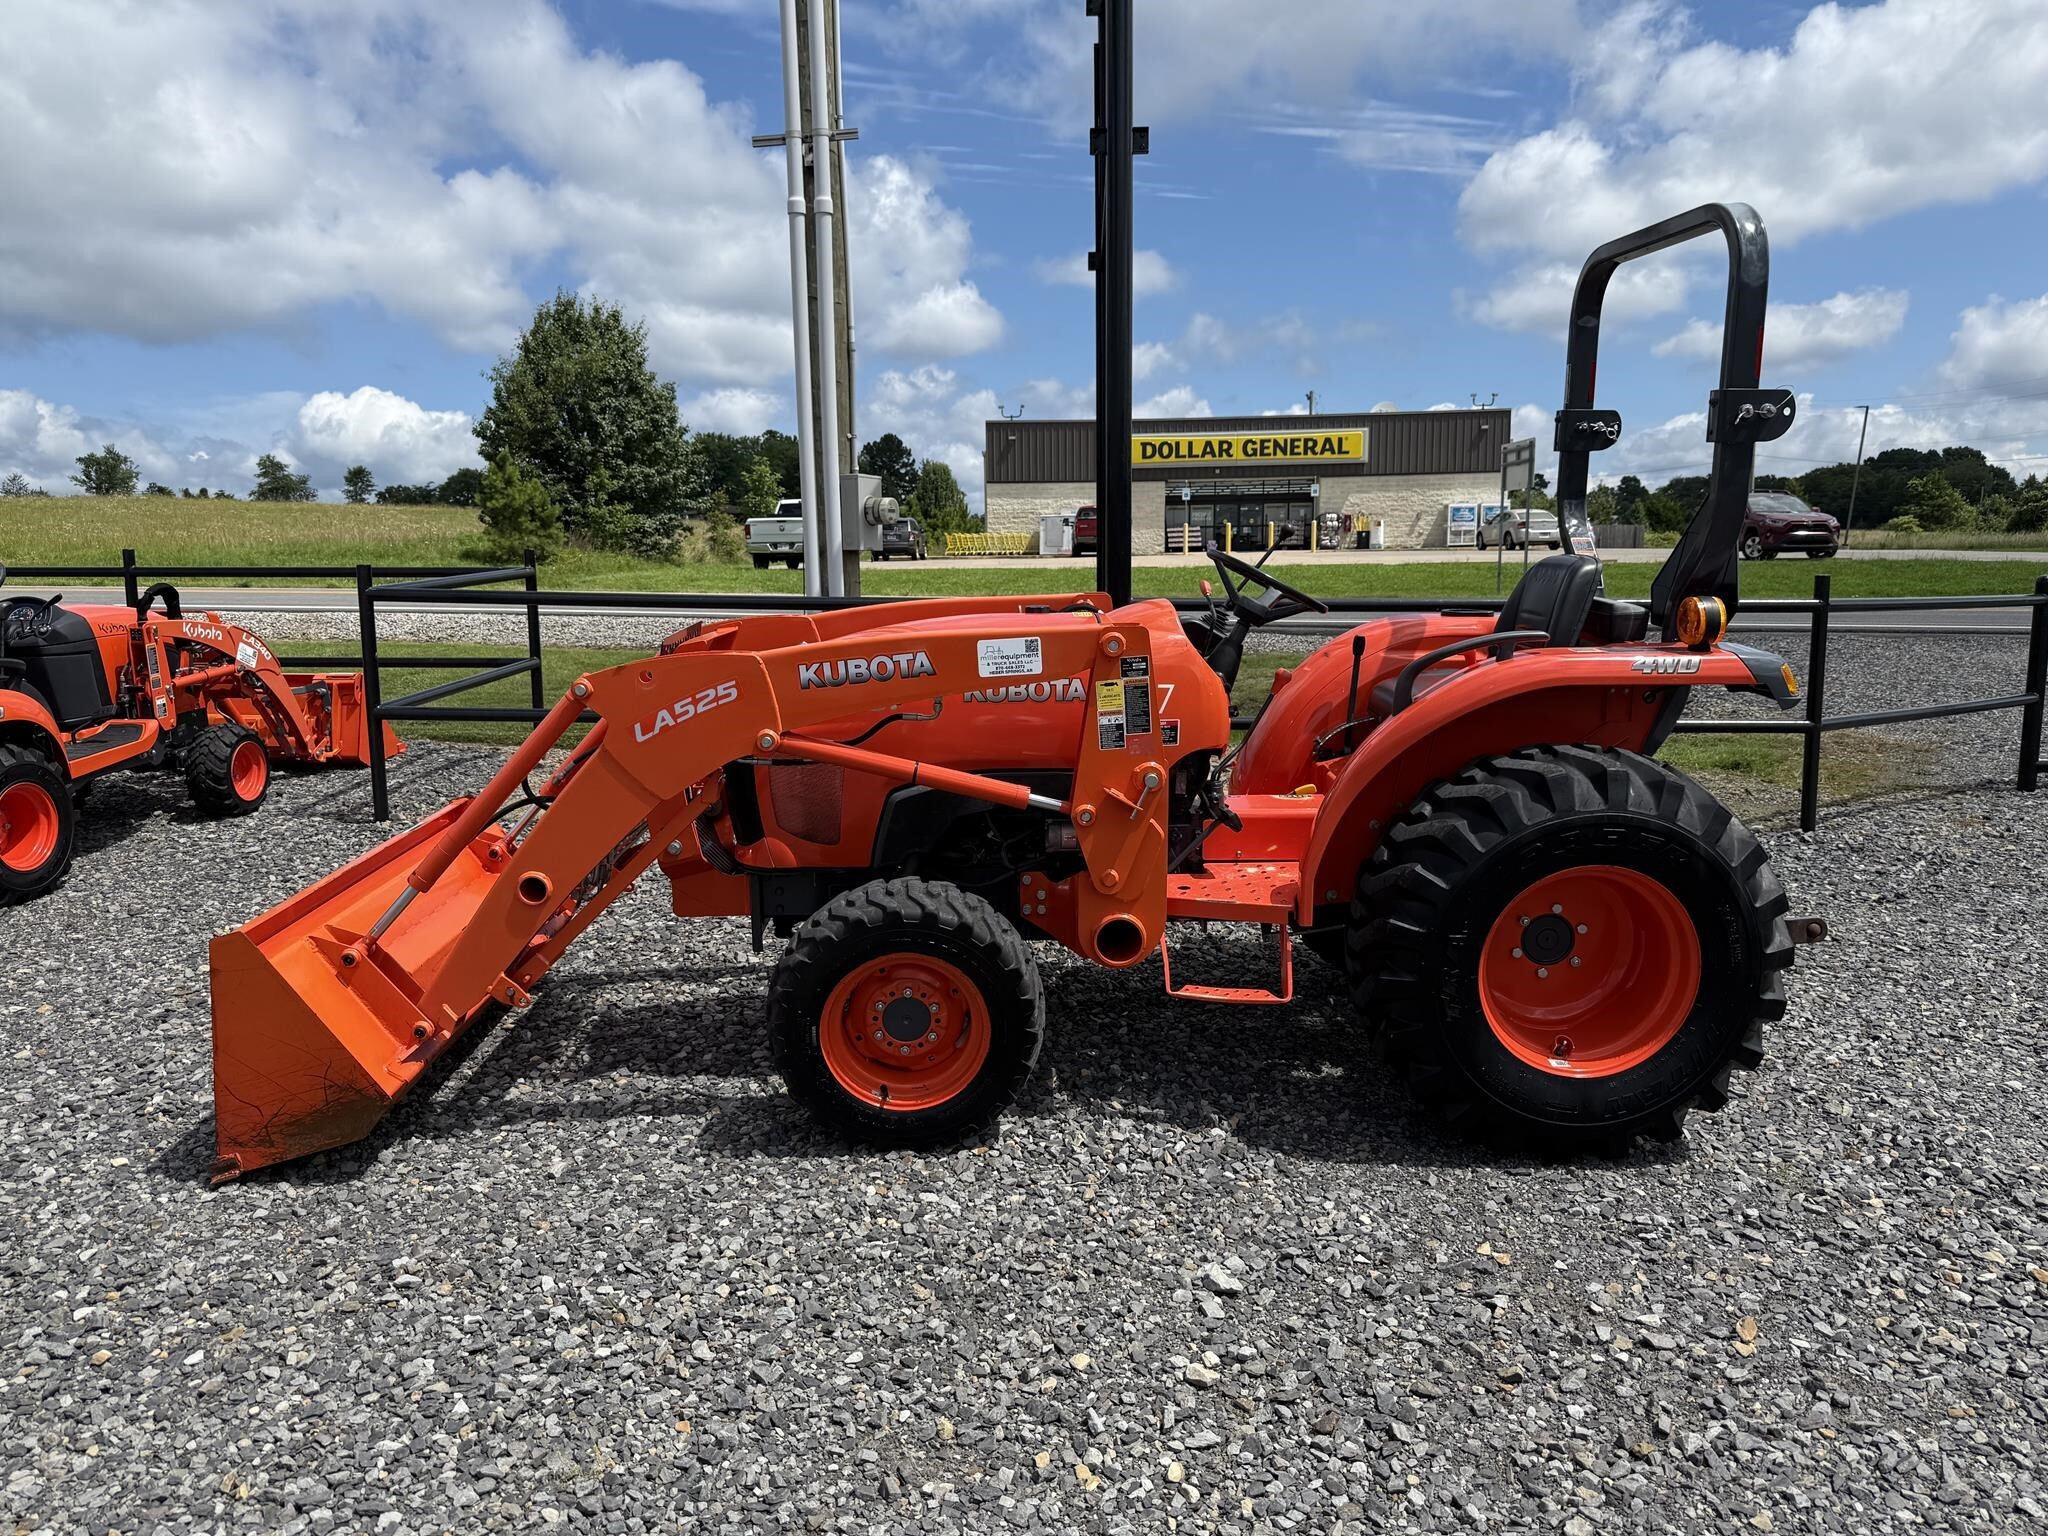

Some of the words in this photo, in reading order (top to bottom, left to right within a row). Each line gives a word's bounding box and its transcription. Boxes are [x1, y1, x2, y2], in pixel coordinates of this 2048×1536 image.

[1140, 439, 1234, 459] DOLLAR
[1242, 436, 1350, 457] GENERAL
[183, 621, 223, 641] Kubota
[242, 632, 272, 661] LA340
[798, 650, 936, 690] KUBOTA
[1631, 655, 1702, 675] 4WD
[634, 679, 739, 743] LA525
[1157, 684, 1175, 714] 7
